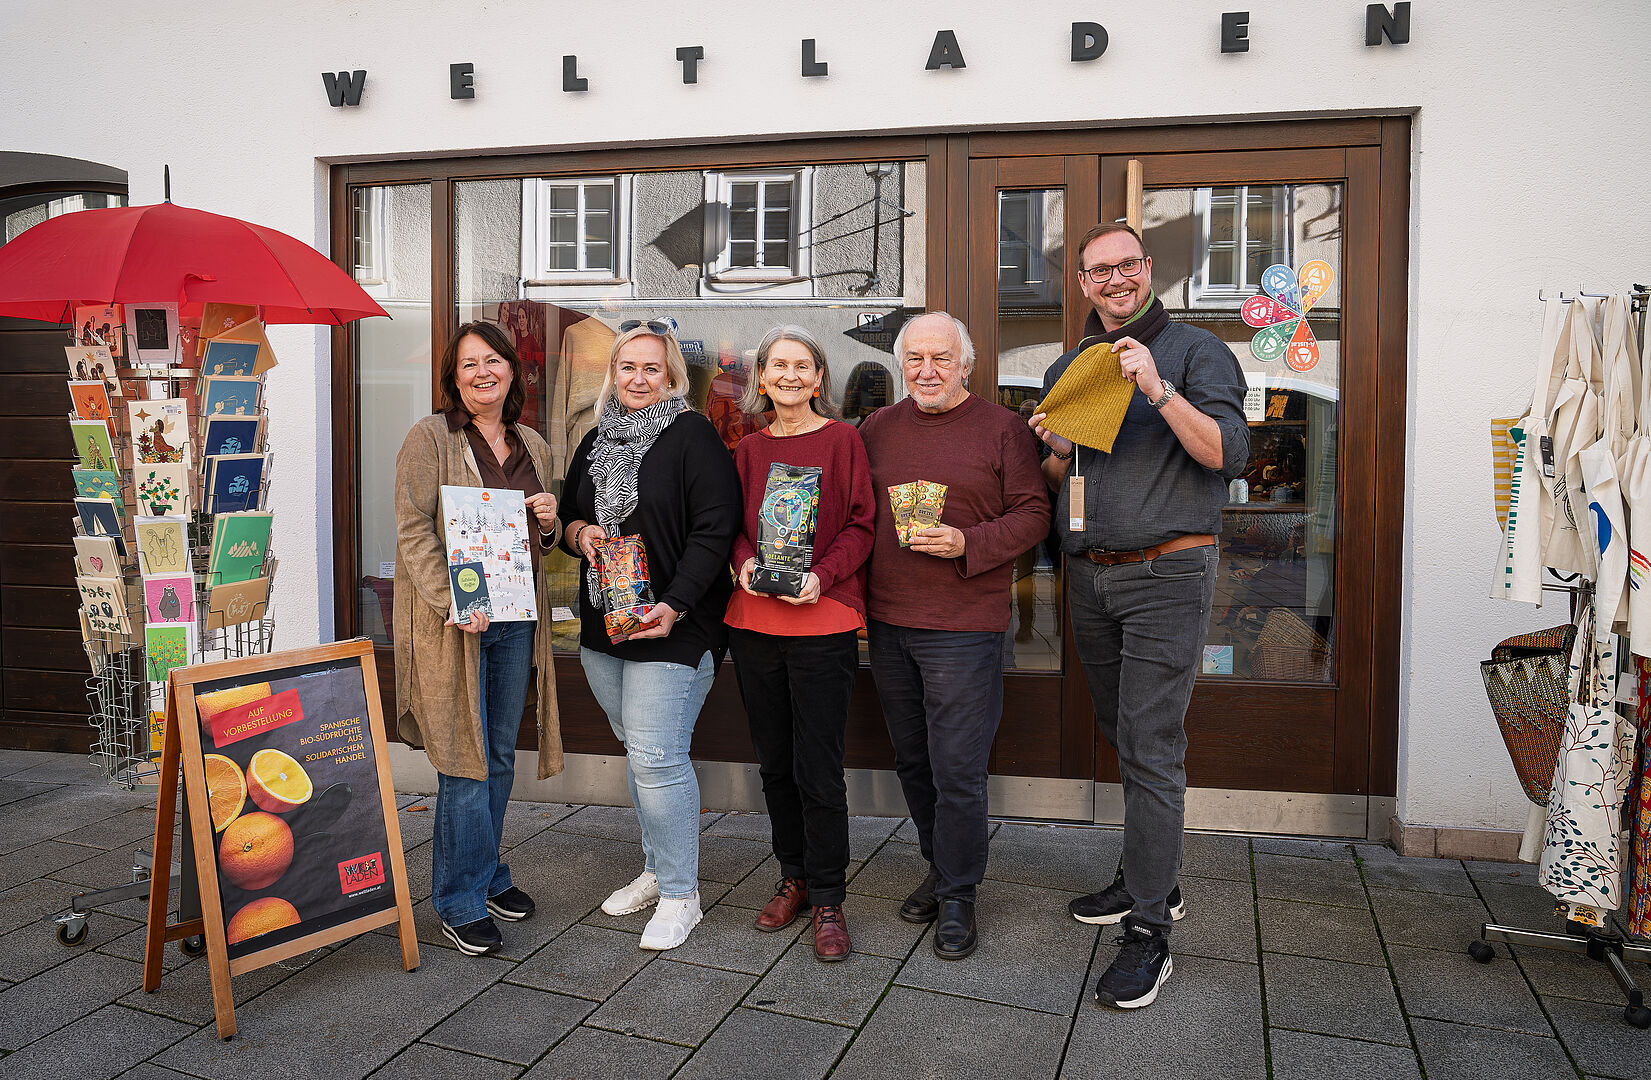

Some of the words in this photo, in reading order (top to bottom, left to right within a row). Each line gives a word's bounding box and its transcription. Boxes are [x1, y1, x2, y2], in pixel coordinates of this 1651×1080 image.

[321, 1, 1411, 108] WELTLADEN
[248, 706, 265, 719] AUF
[223, 708, 293, 738] VORBESTELLUNG
[320, 716, 360, 732] SPANISCHE
[300, 726, 362, 746] BIO-SÜDFRÜCHTE
[348, 734, 363, 744] AUS
[306, 743, 364, 762] SOLIDARISCHEM
[335, 752, 366, 765] HANDEL
[344, 858, 377, 876] WELT
[346, 868, 378, 886] LADEN
[348, 885, 382, 898] www.weltladen.at
